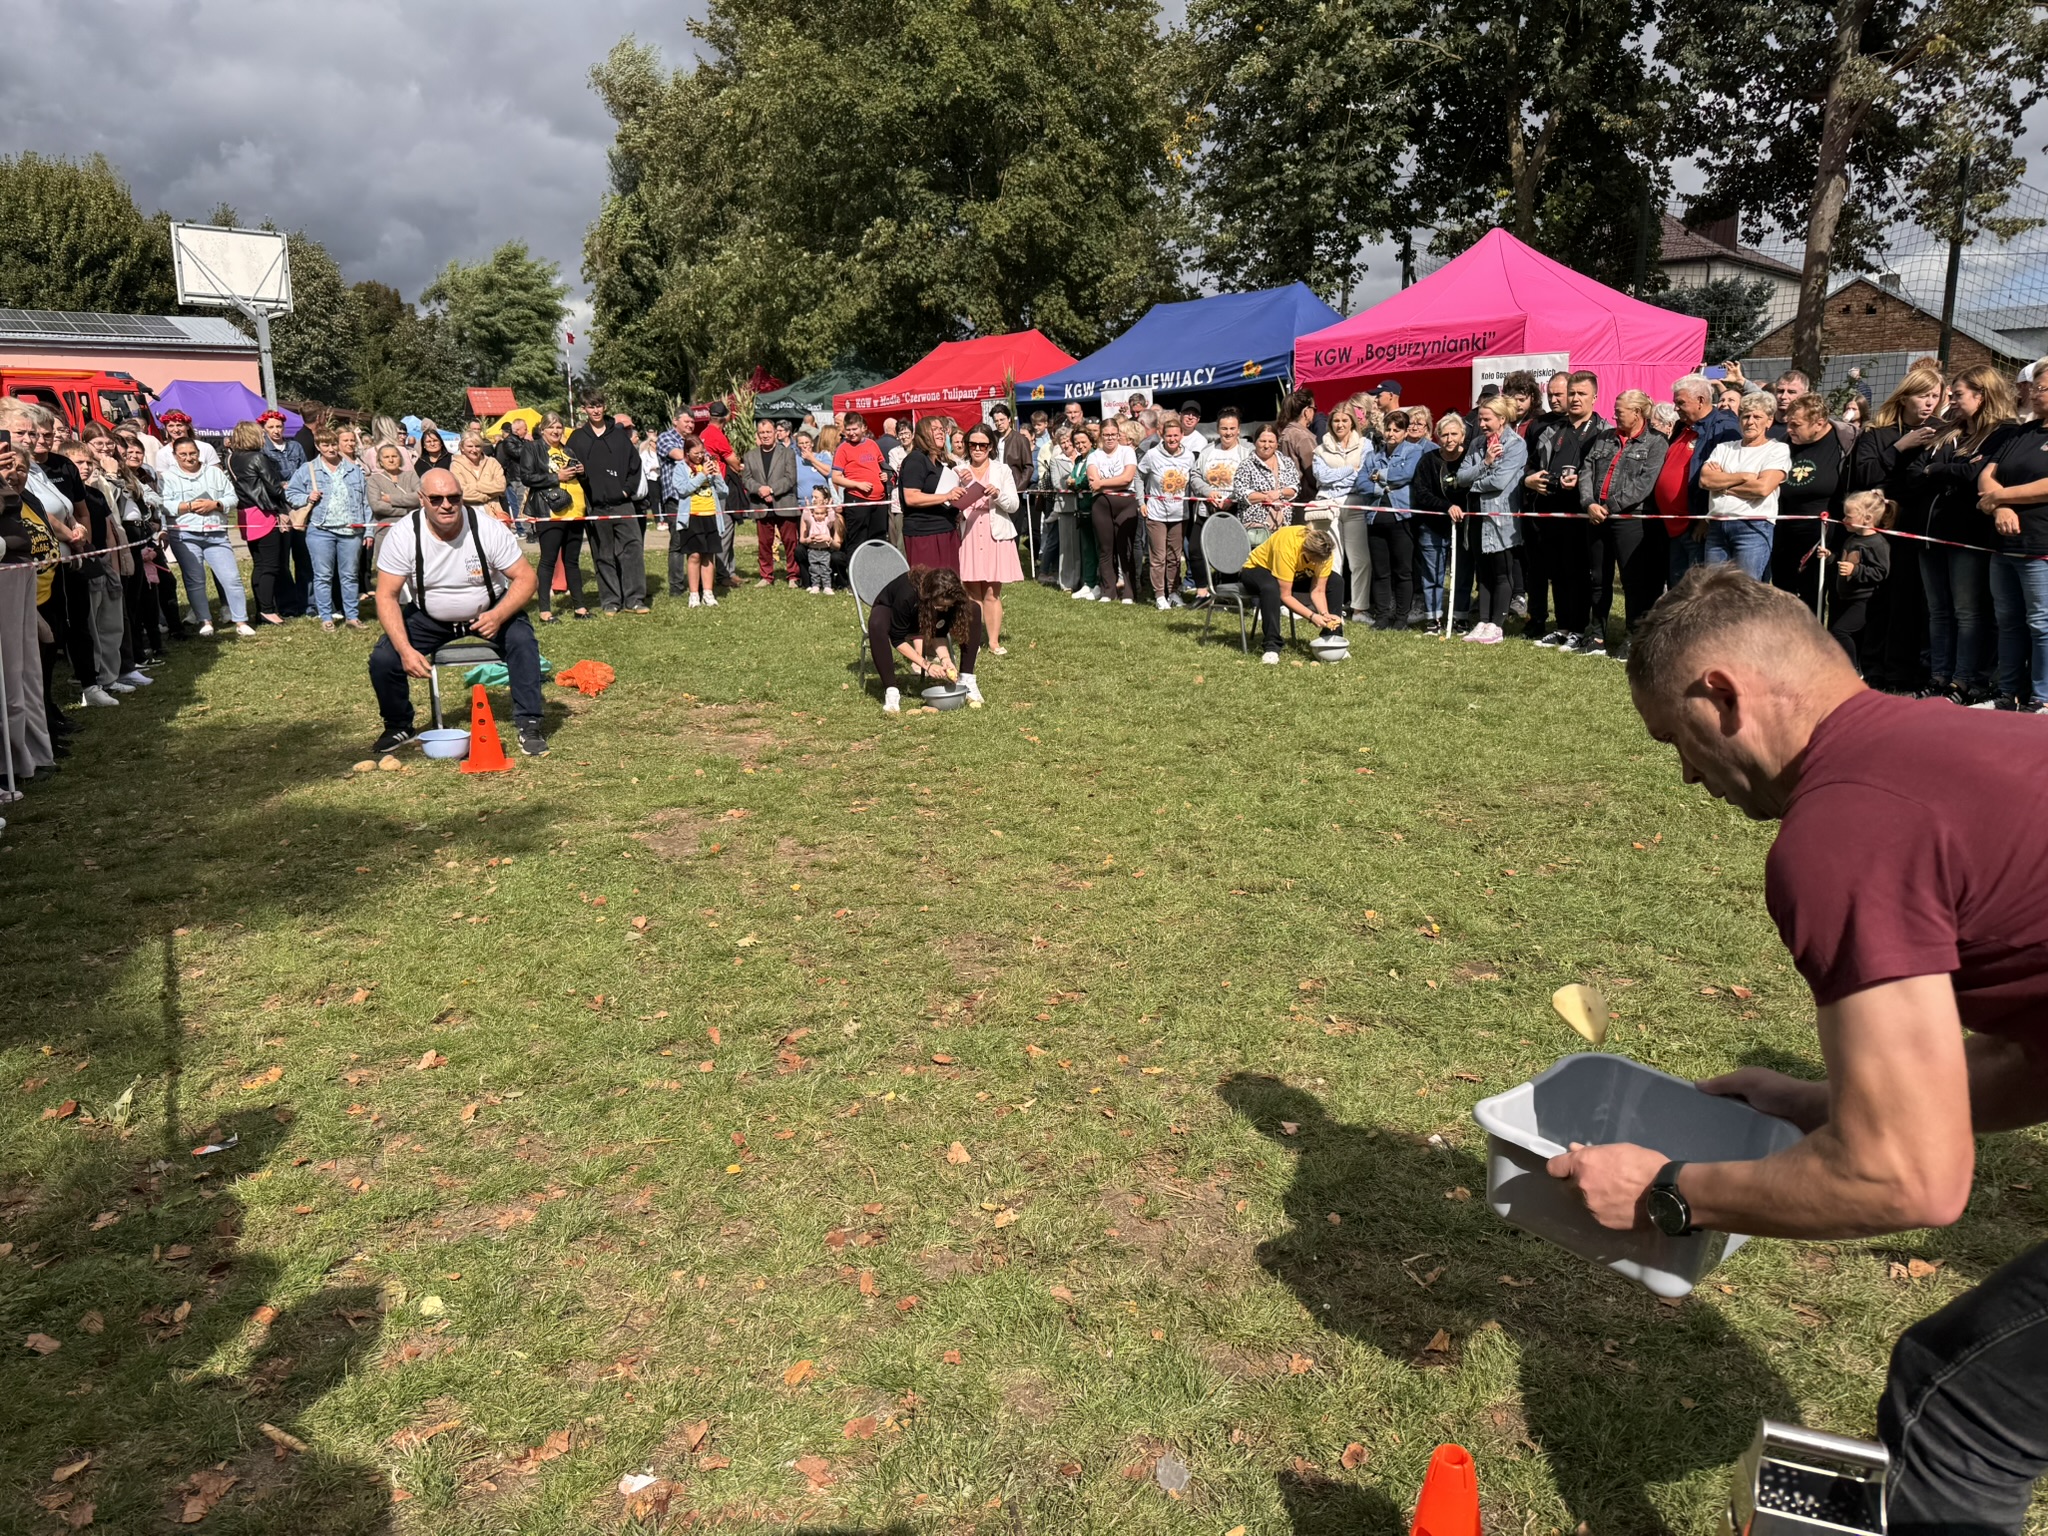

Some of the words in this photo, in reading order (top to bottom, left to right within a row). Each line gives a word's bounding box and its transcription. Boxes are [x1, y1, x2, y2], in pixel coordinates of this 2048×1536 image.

[1314, 346, 1352, 367] KGW
[855, 397, 873, 408] KGW
[942, 386, 982, 401] Tulipany"
[1064, 381, 1096, 399] KGW
